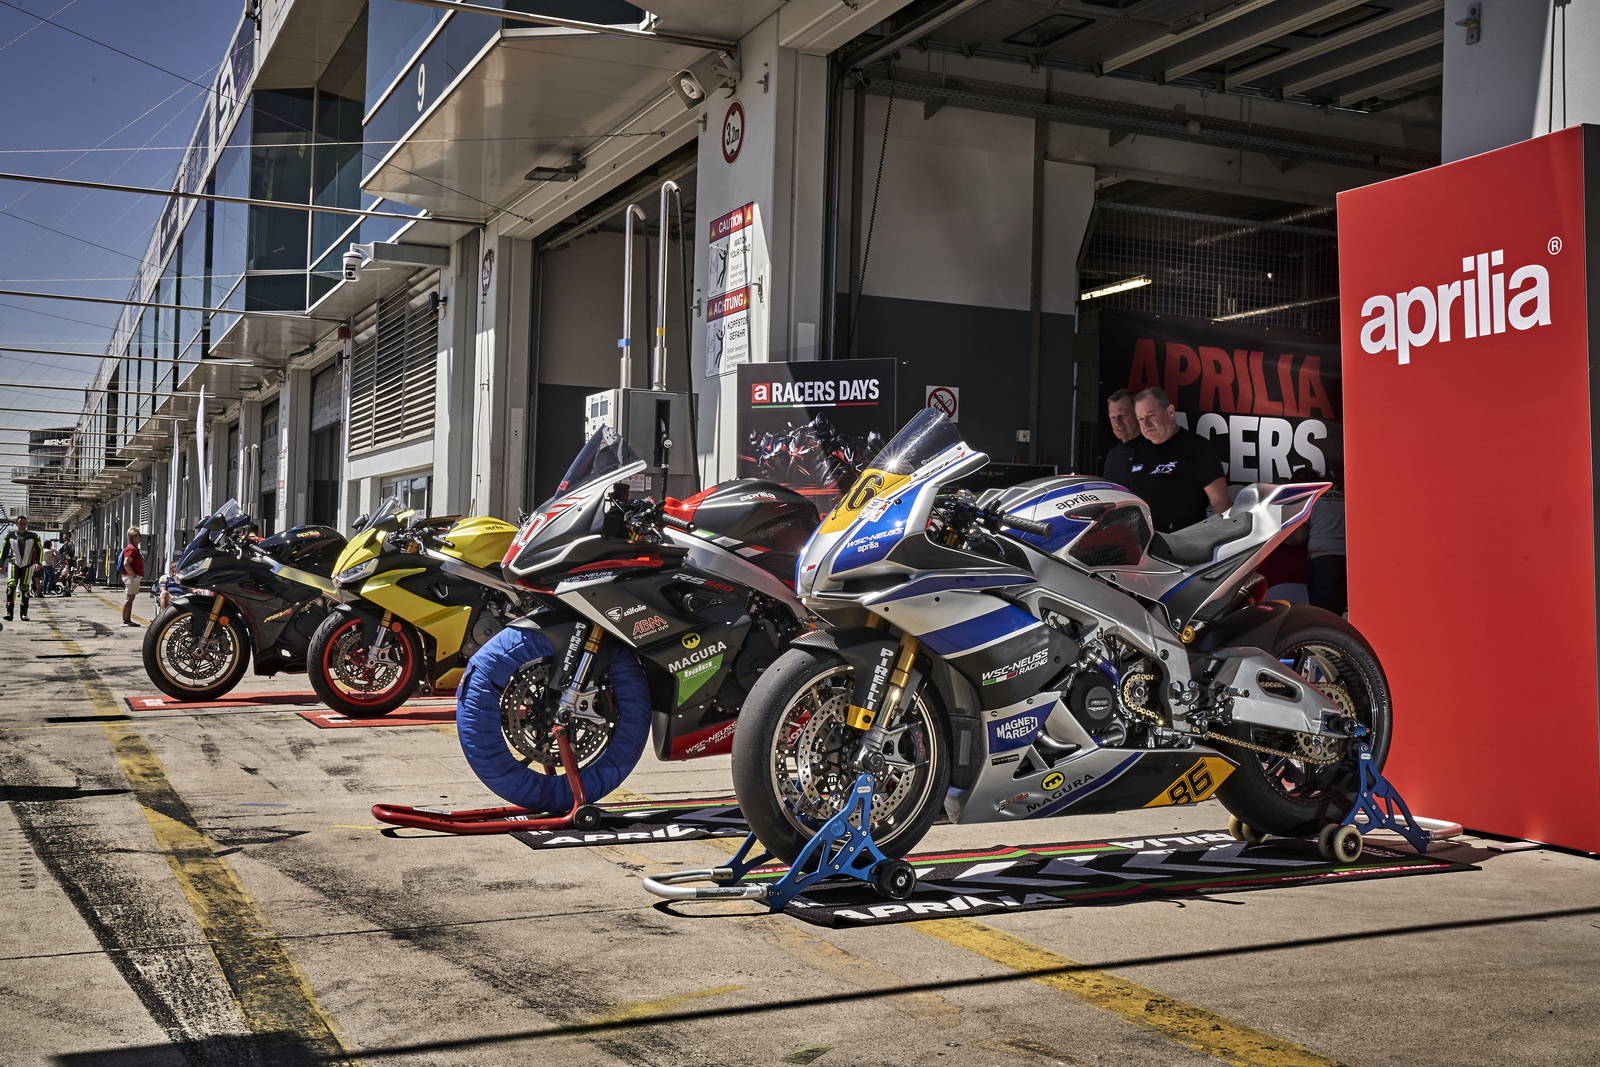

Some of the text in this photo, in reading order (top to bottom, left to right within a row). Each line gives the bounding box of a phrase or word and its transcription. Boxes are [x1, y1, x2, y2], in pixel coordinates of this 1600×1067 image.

[417, 63, 426, 112] 9
[718, 212, 743, 233] CAUTION
[713, 292, 744, 315] ACHTUNG
[1360, 249, 1552, 365] aprilia
[1127, 338, 1337, 419] APRILIA
[771, 380, 836, 403] RACERS
[839, 379, 880, 401] DAYS
[1174, 411, 1328, 483] CERS
[740, 491, 777, 502] aprilia
[1055, 493, 1101, 511] aprilia
[847, 527, 905, 549] WSC-NEUSS
[857, 541, 879, 553] aprilia
[632, 615, 668, 636] ABM
[563, 621, 587, 671] PIRELLI
[668, 641, 727, 674] MAGURA
[982, 647, 1049, 681] WSC-NEUSS
[1018, 657, 1048, 675] RACING
[867, 647, 894, 711] PIRELLI
[996, 716, 1038, 737] MAGNETI
[997, 721, 1038, 740] MARELLI
[1026, 774, 1095, 812] MAGURA
[833, 893, 1067, 920] APRILIA
